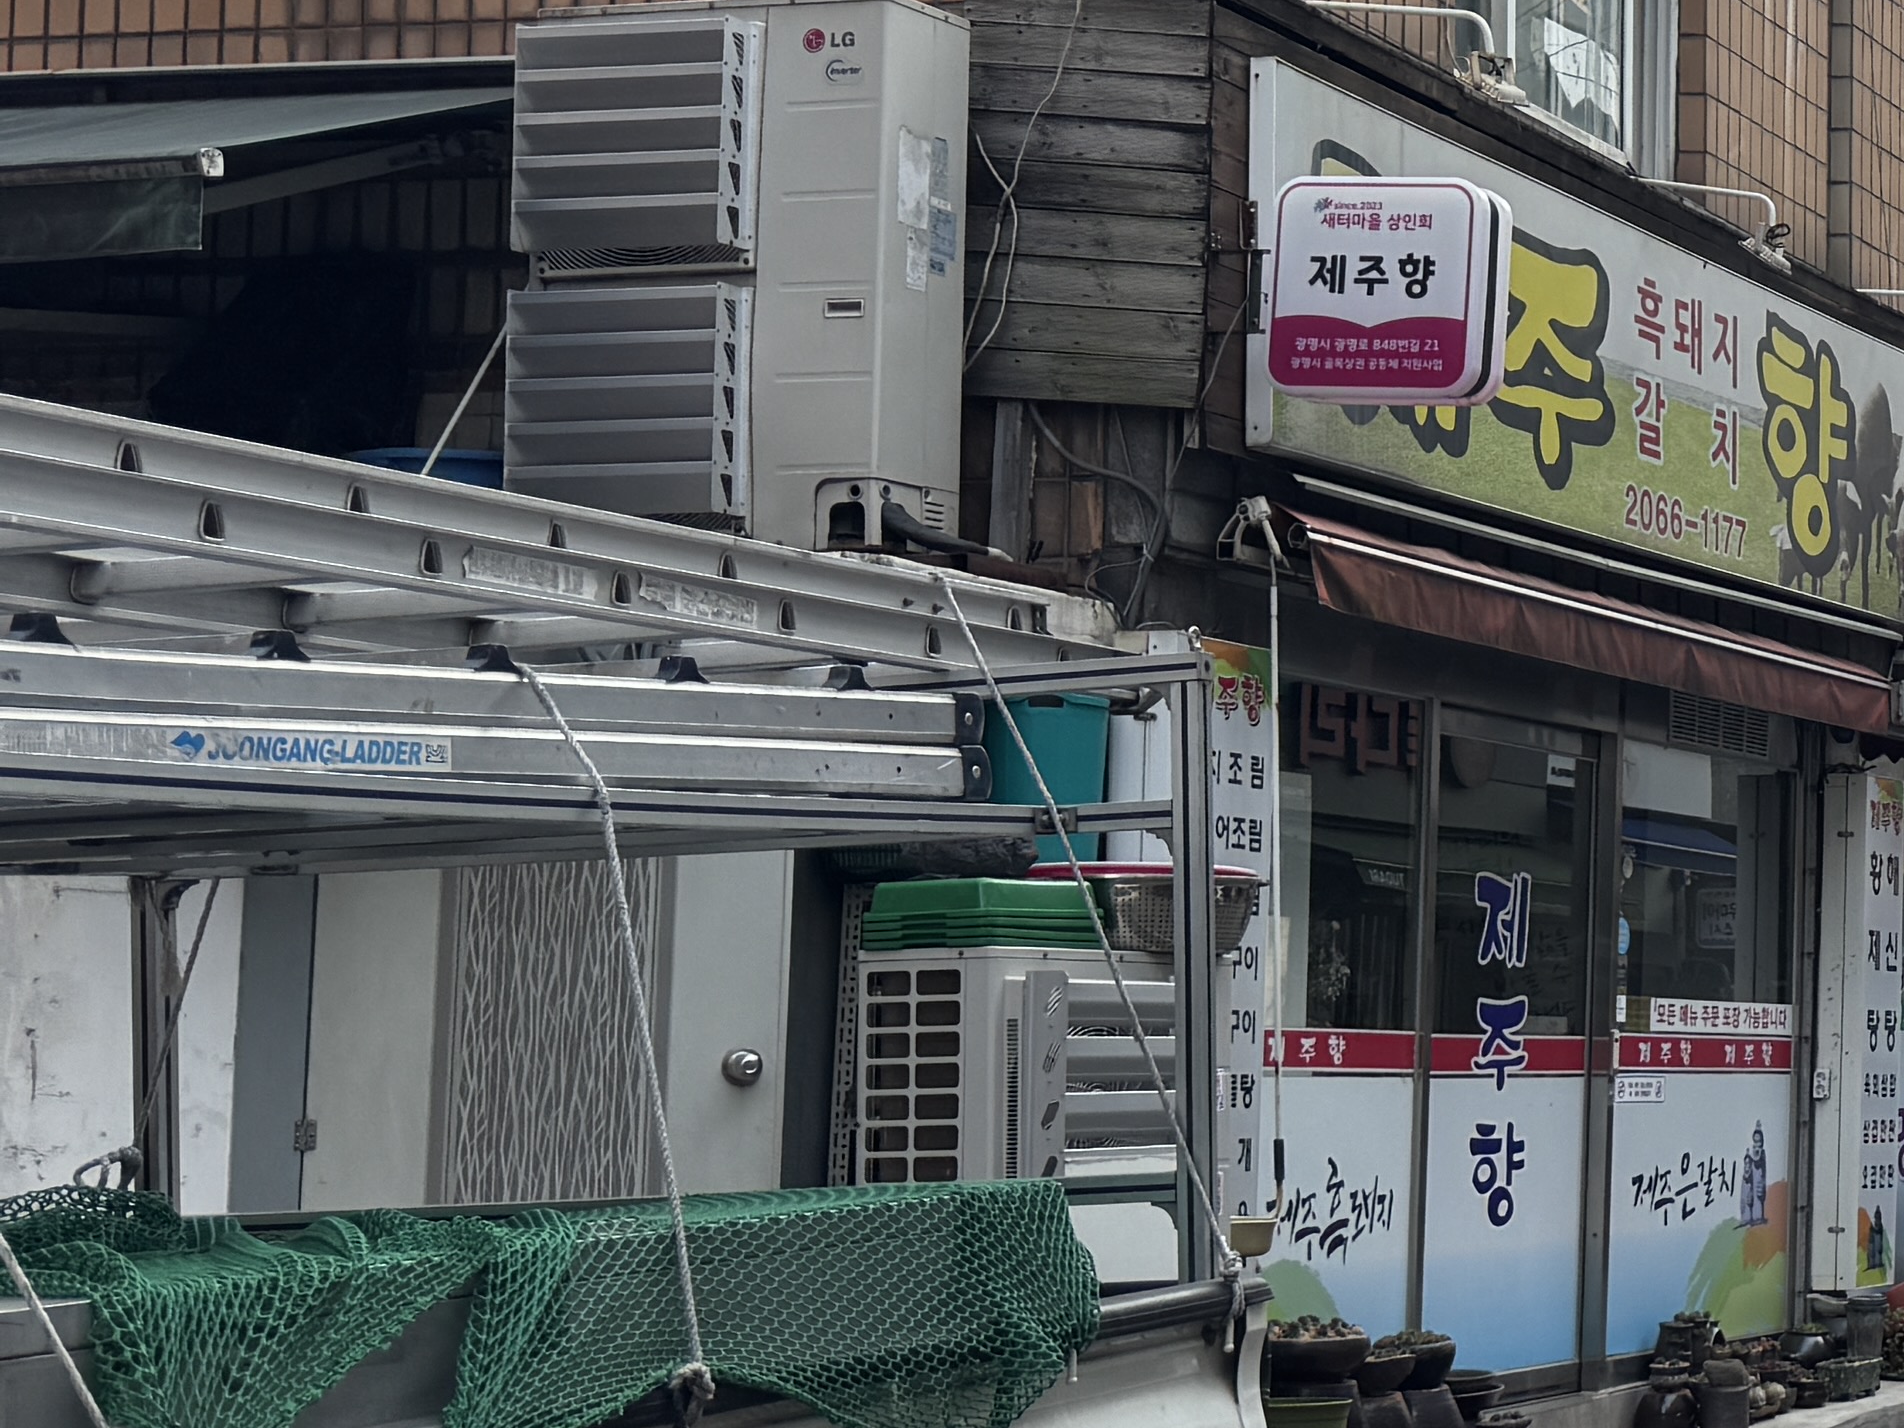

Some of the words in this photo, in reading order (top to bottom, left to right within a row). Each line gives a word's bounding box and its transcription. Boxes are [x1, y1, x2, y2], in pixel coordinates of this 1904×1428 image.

[831, 32, 855, 48] LG
[1321, 213, 1382, 231] 새터마을
[1387, 213, 1433, 231] 상인회
[1308, 252, 1436, 299] 제주향
[1634, 277, 1738, 389] 흑돼지
[1634, 375, 1740, 485] 갈치
[1624, 483, 1748, 559] 2066-1177
[1656, 1003, 1677, 1026] 모든
[1701, 1004, 1719, 1027] 주문
[1743, 1005, 1787, 1030] 가능합니다
[1470, 872, 1531, 1227] 제주향
